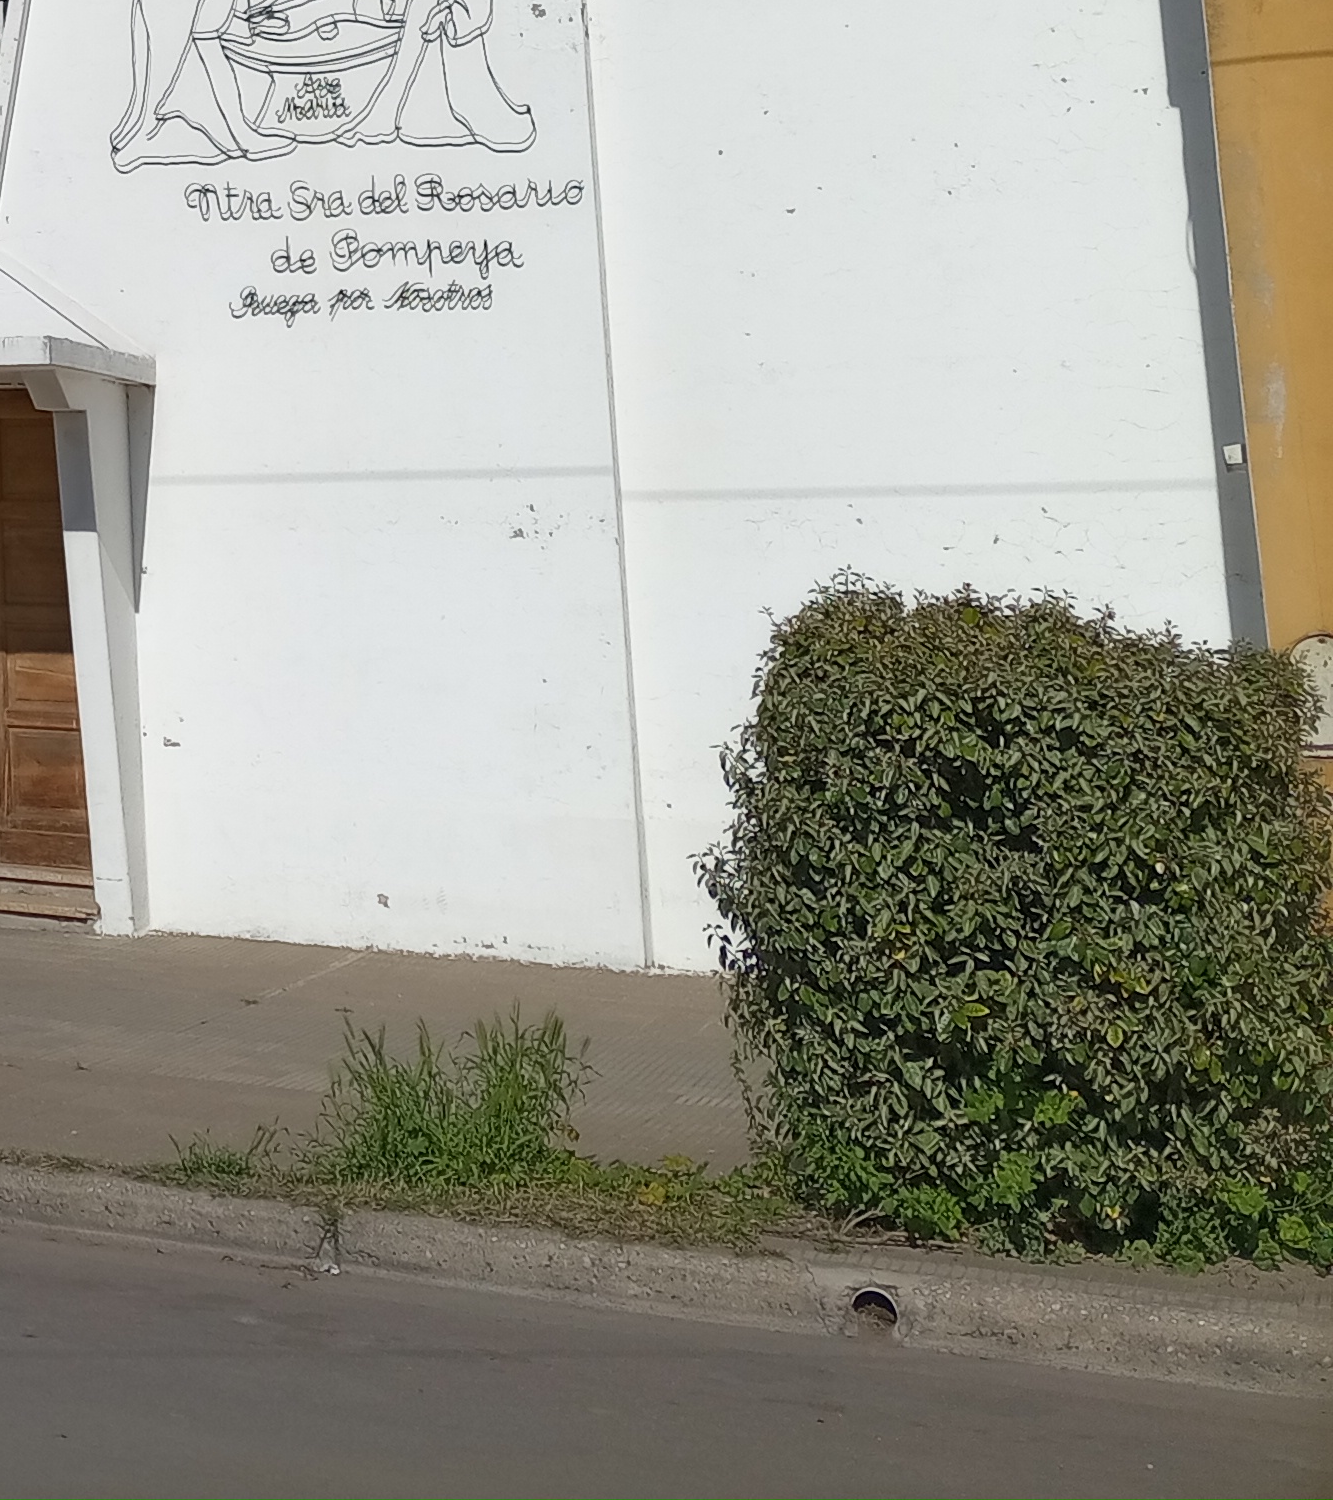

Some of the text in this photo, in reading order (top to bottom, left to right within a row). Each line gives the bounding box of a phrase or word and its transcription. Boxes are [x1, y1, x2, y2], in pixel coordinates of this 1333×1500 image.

[294, 73, 342, 100] Ave
[184, 173, 585, 222] Ntra Sra del Rosario
[271, 228, 524, 280] de Pompeya
[229, 285, 321, 328] Ruega
[328, 287, 375, 322] por
